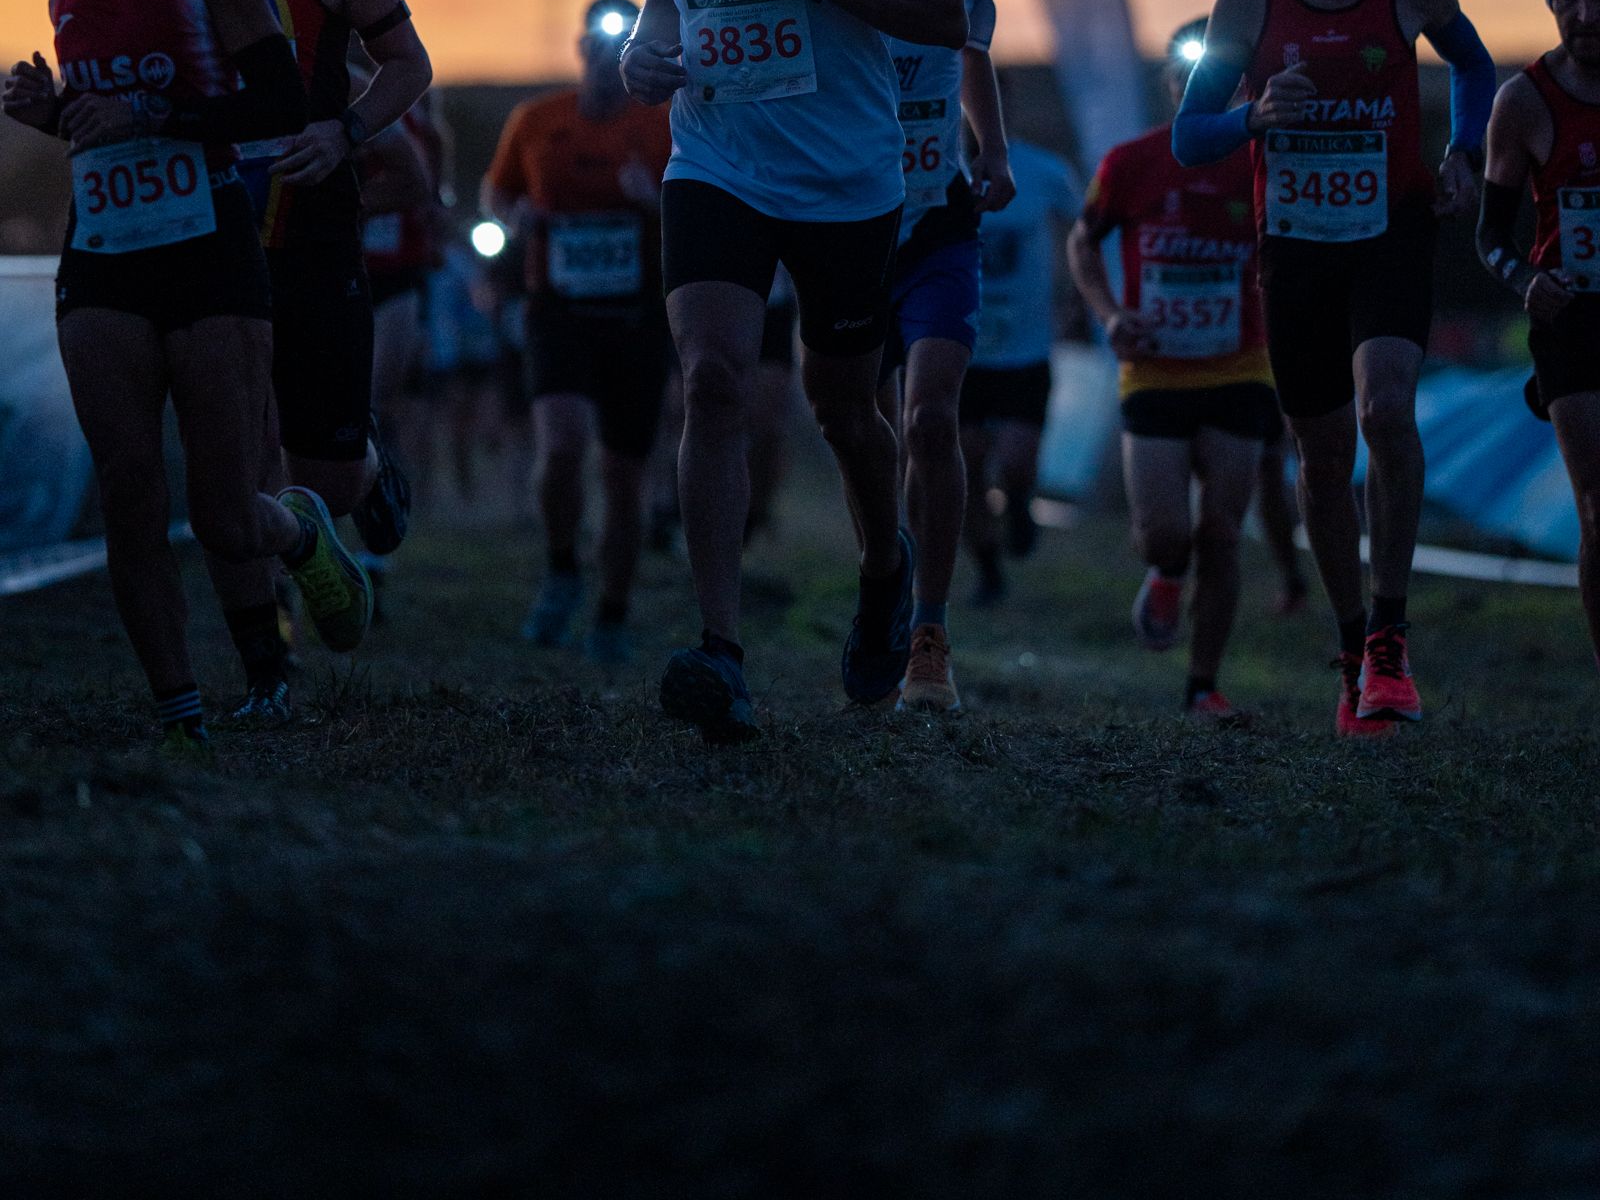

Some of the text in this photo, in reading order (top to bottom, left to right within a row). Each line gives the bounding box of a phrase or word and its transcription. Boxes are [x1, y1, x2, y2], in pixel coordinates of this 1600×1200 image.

[698, 18, 801, 67] 3836
[63, 51, 177, 93] ULSO
[1303, 95, 1397, 123] RTAMA
[903, 135, 940, 174] 56
[83, 153, 196, 215] 3050
[1278, 169, 1378, 207] 3489
[1573, 226, 1596, 260] 3
[1151, 298, 1233, 330] 3557
